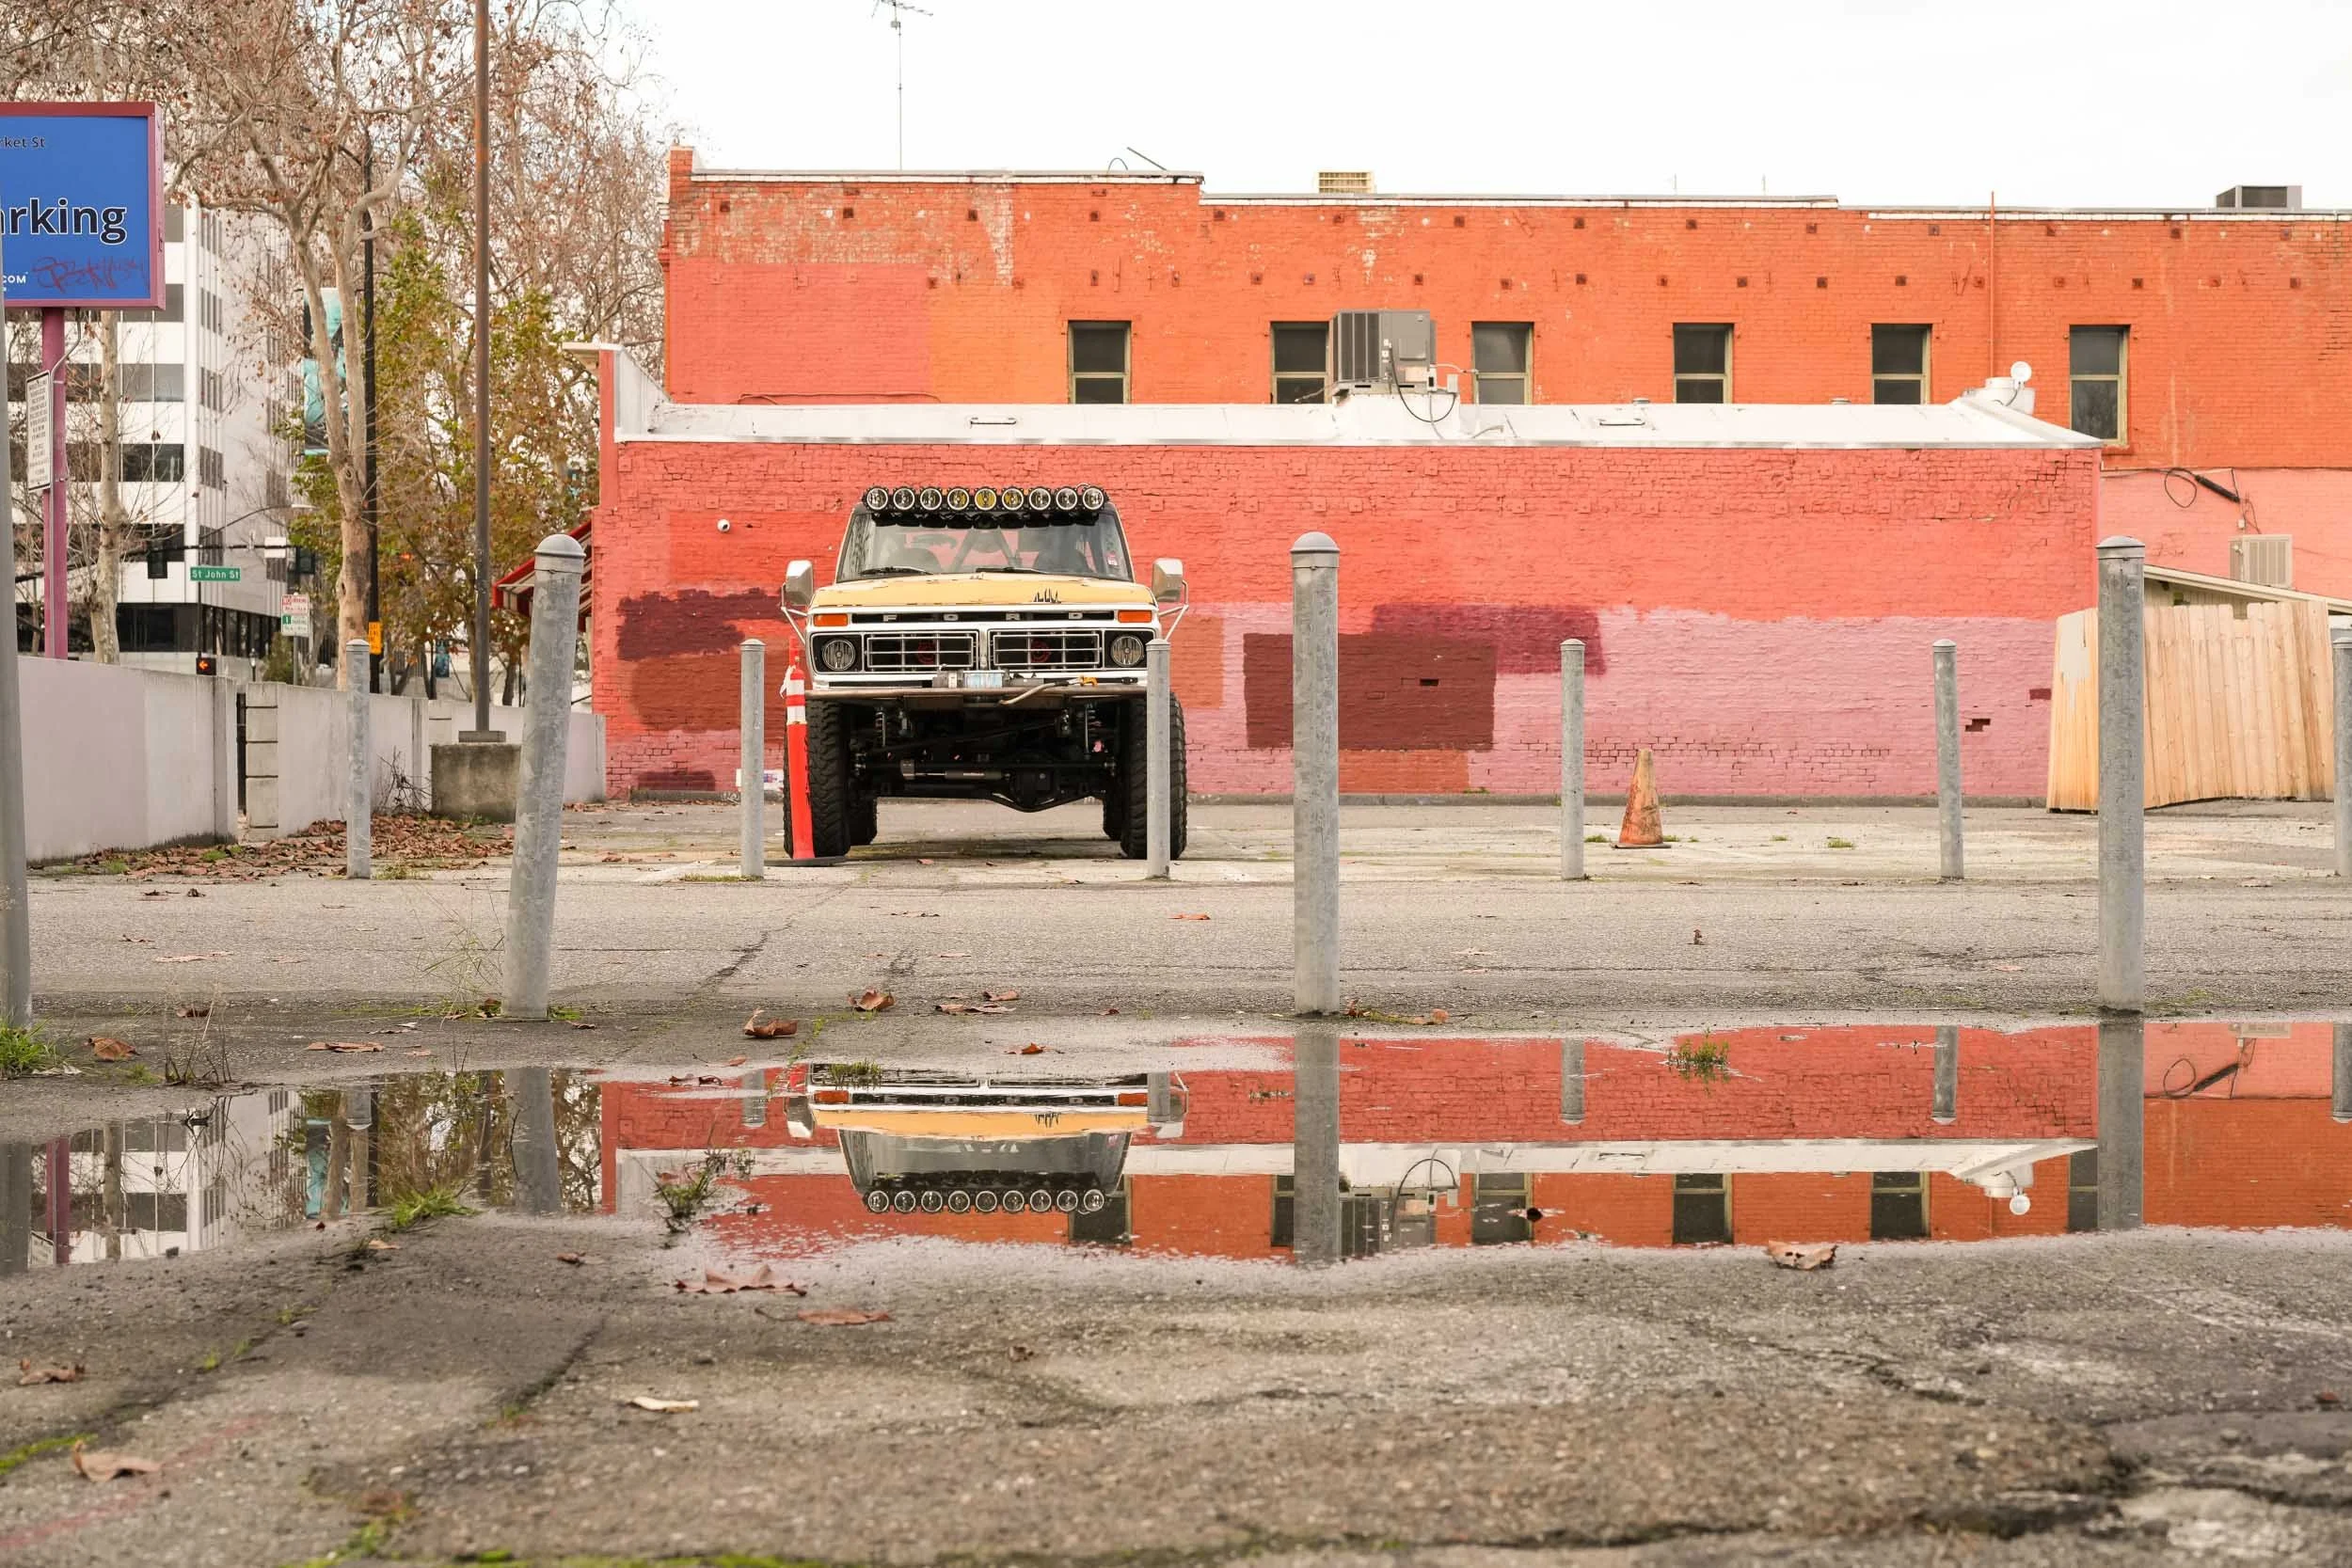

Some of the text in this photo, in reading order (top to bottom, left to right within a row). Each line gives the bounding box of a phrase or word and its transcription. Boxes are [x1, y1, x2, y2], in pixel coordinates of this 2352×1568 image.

[32, 136, 45, 148] St
[192, 569, 239, 579] St John St
[882, 610, 1084, 622] FORD
